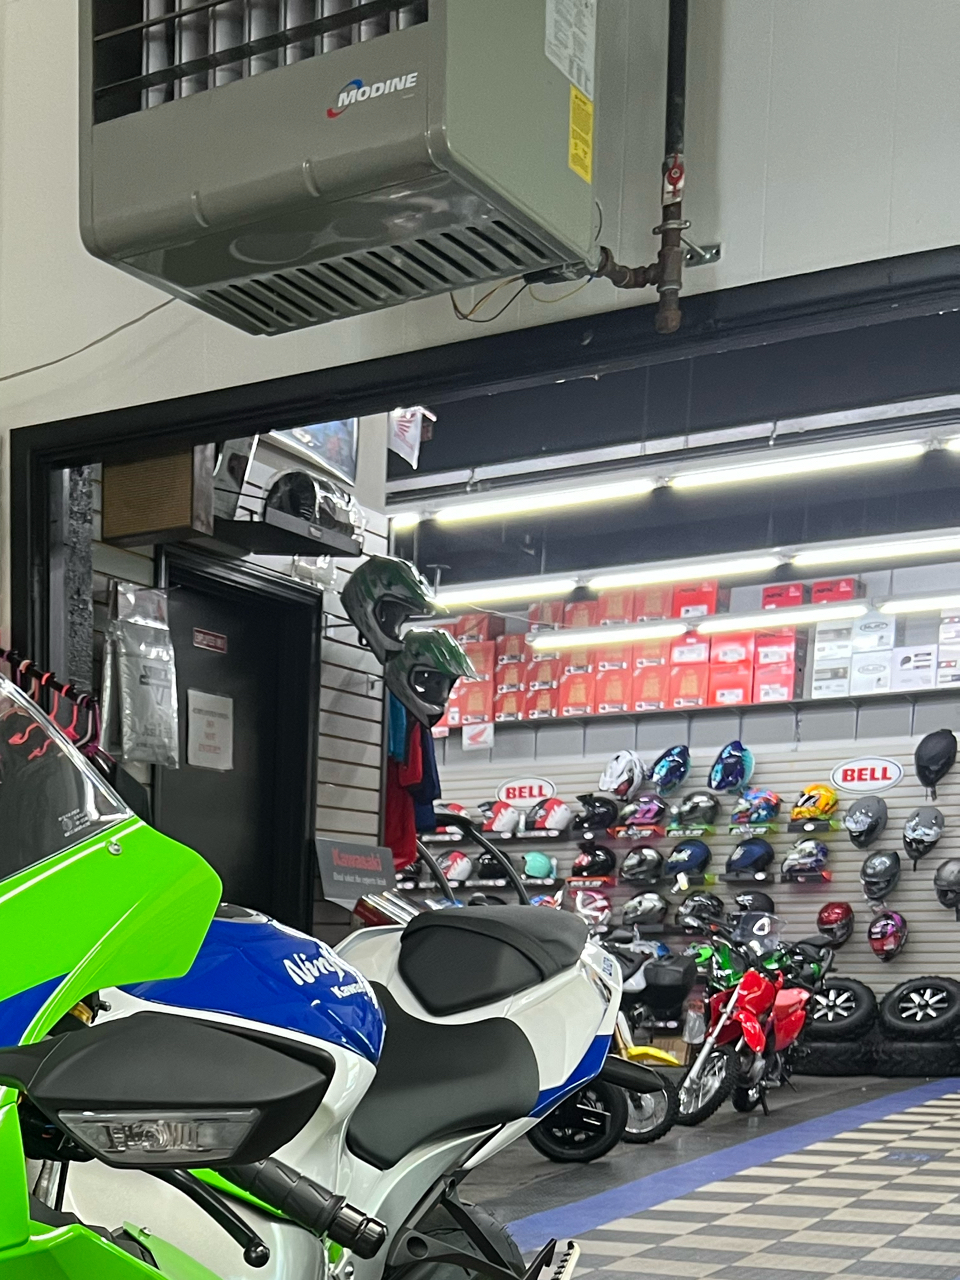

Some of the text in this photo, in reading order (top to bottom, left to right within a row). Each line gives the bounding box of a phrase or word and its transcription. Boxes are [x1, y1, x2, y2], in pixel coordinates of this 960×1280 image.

[338, 72, 418, 107] MODINE
[842, 767, 893, 783] BELL
[505, 785, 548, 800] BELL
